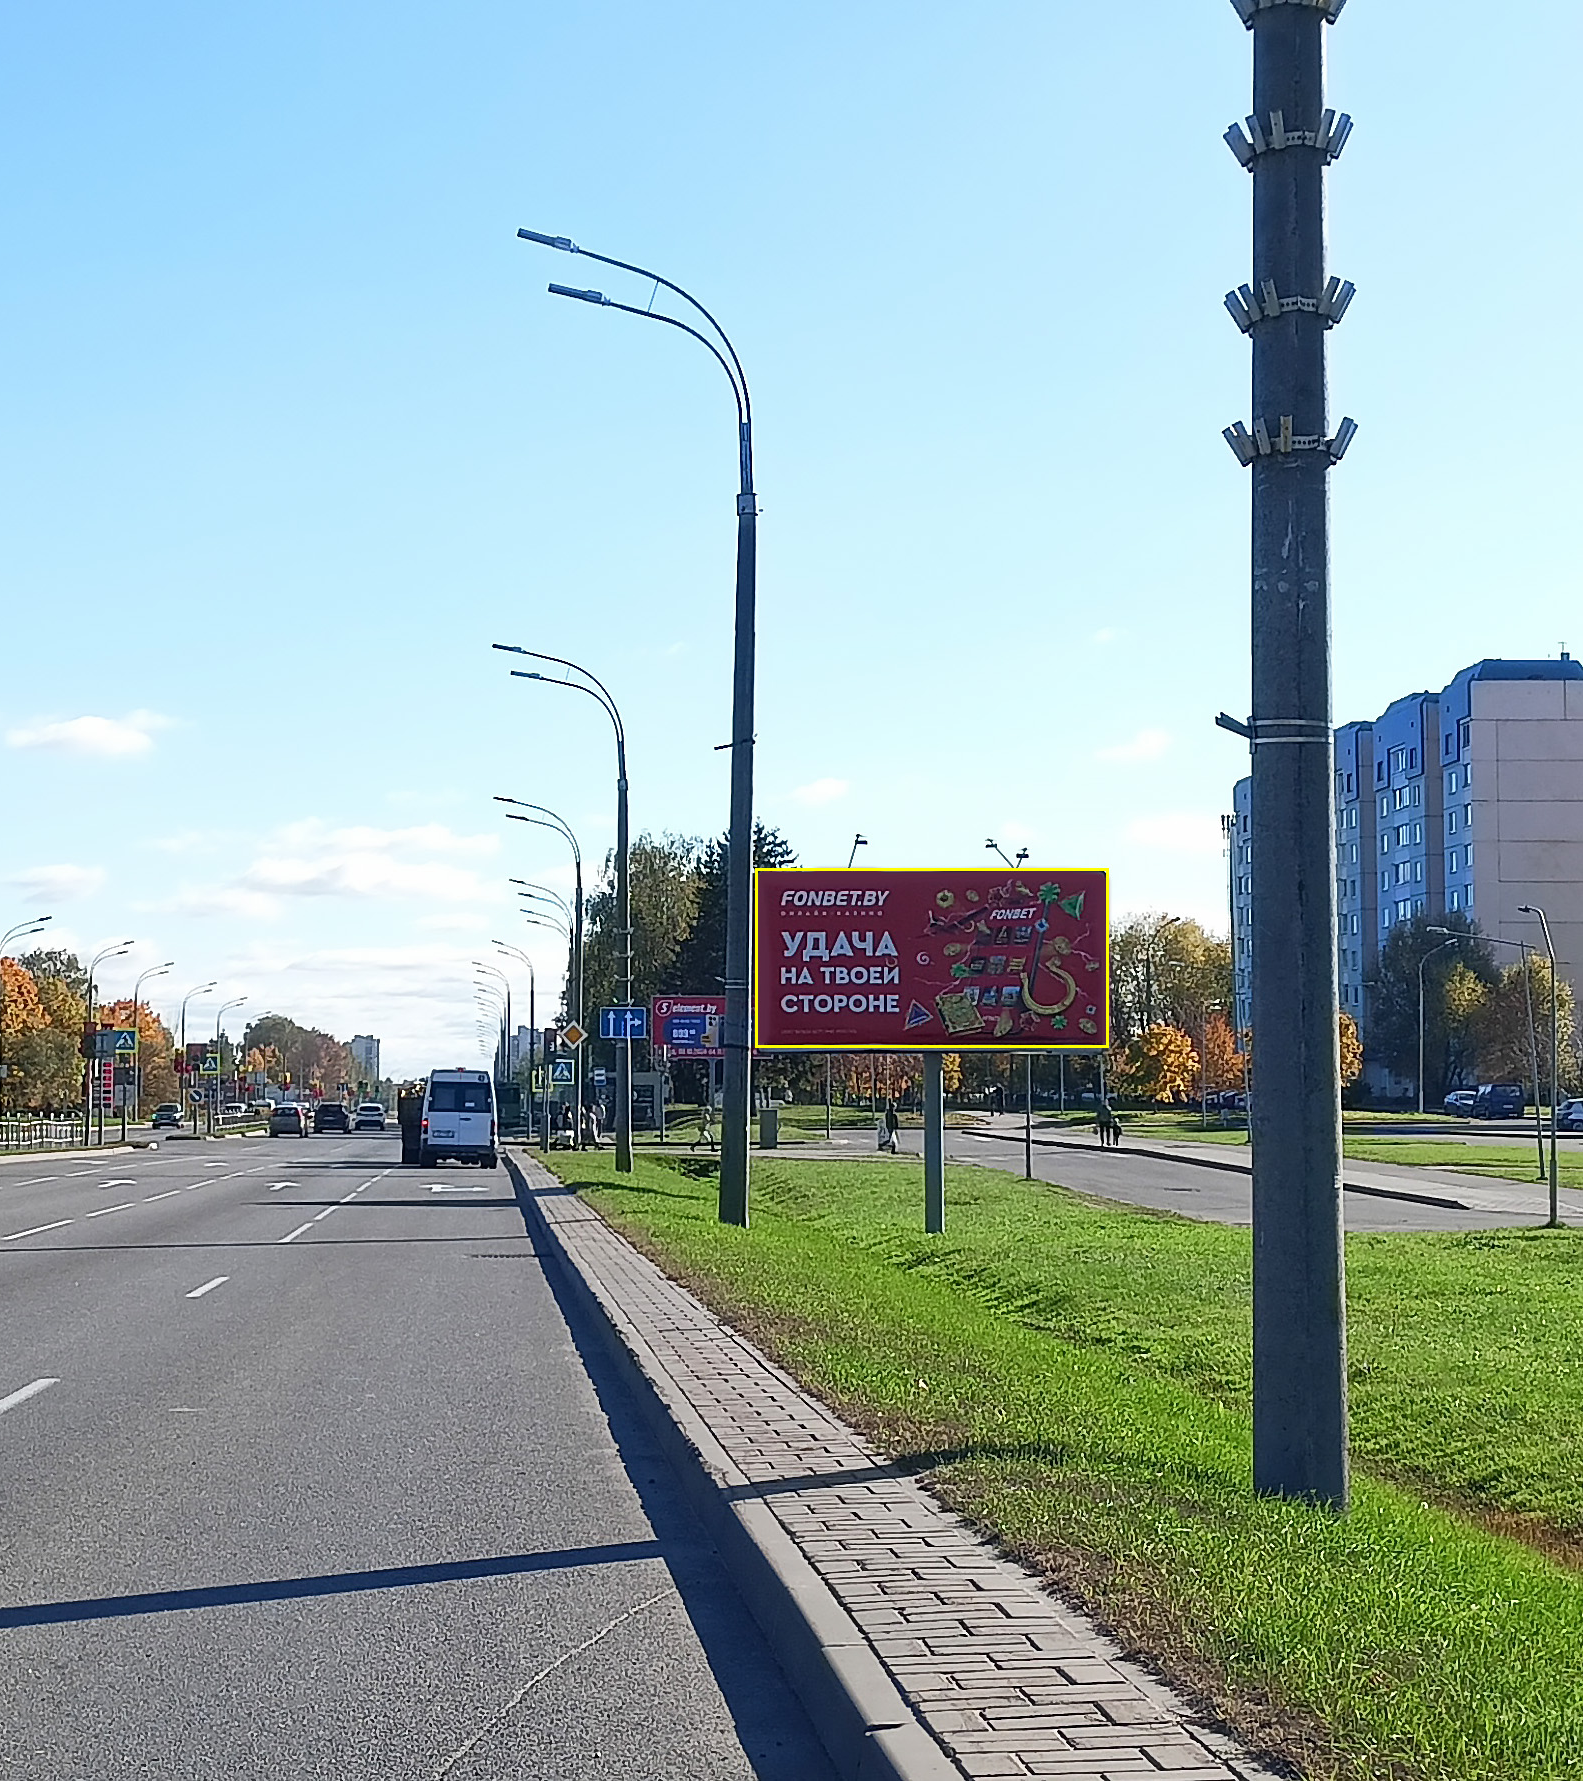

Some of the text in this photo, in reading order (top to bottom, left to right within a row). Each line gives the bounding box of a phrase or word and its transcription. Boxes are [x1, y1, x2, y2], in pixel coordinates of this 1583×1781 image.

[780, 890, 890, 906] FONBET.BY
[989, 907, 1037, 920] FONBET
[780, 930, 899, 962] УДАЧА
[780, 958, 900, 985] НА ТВОЕЙ
[780, 994, 900, 1013] СТОРОНЕ
